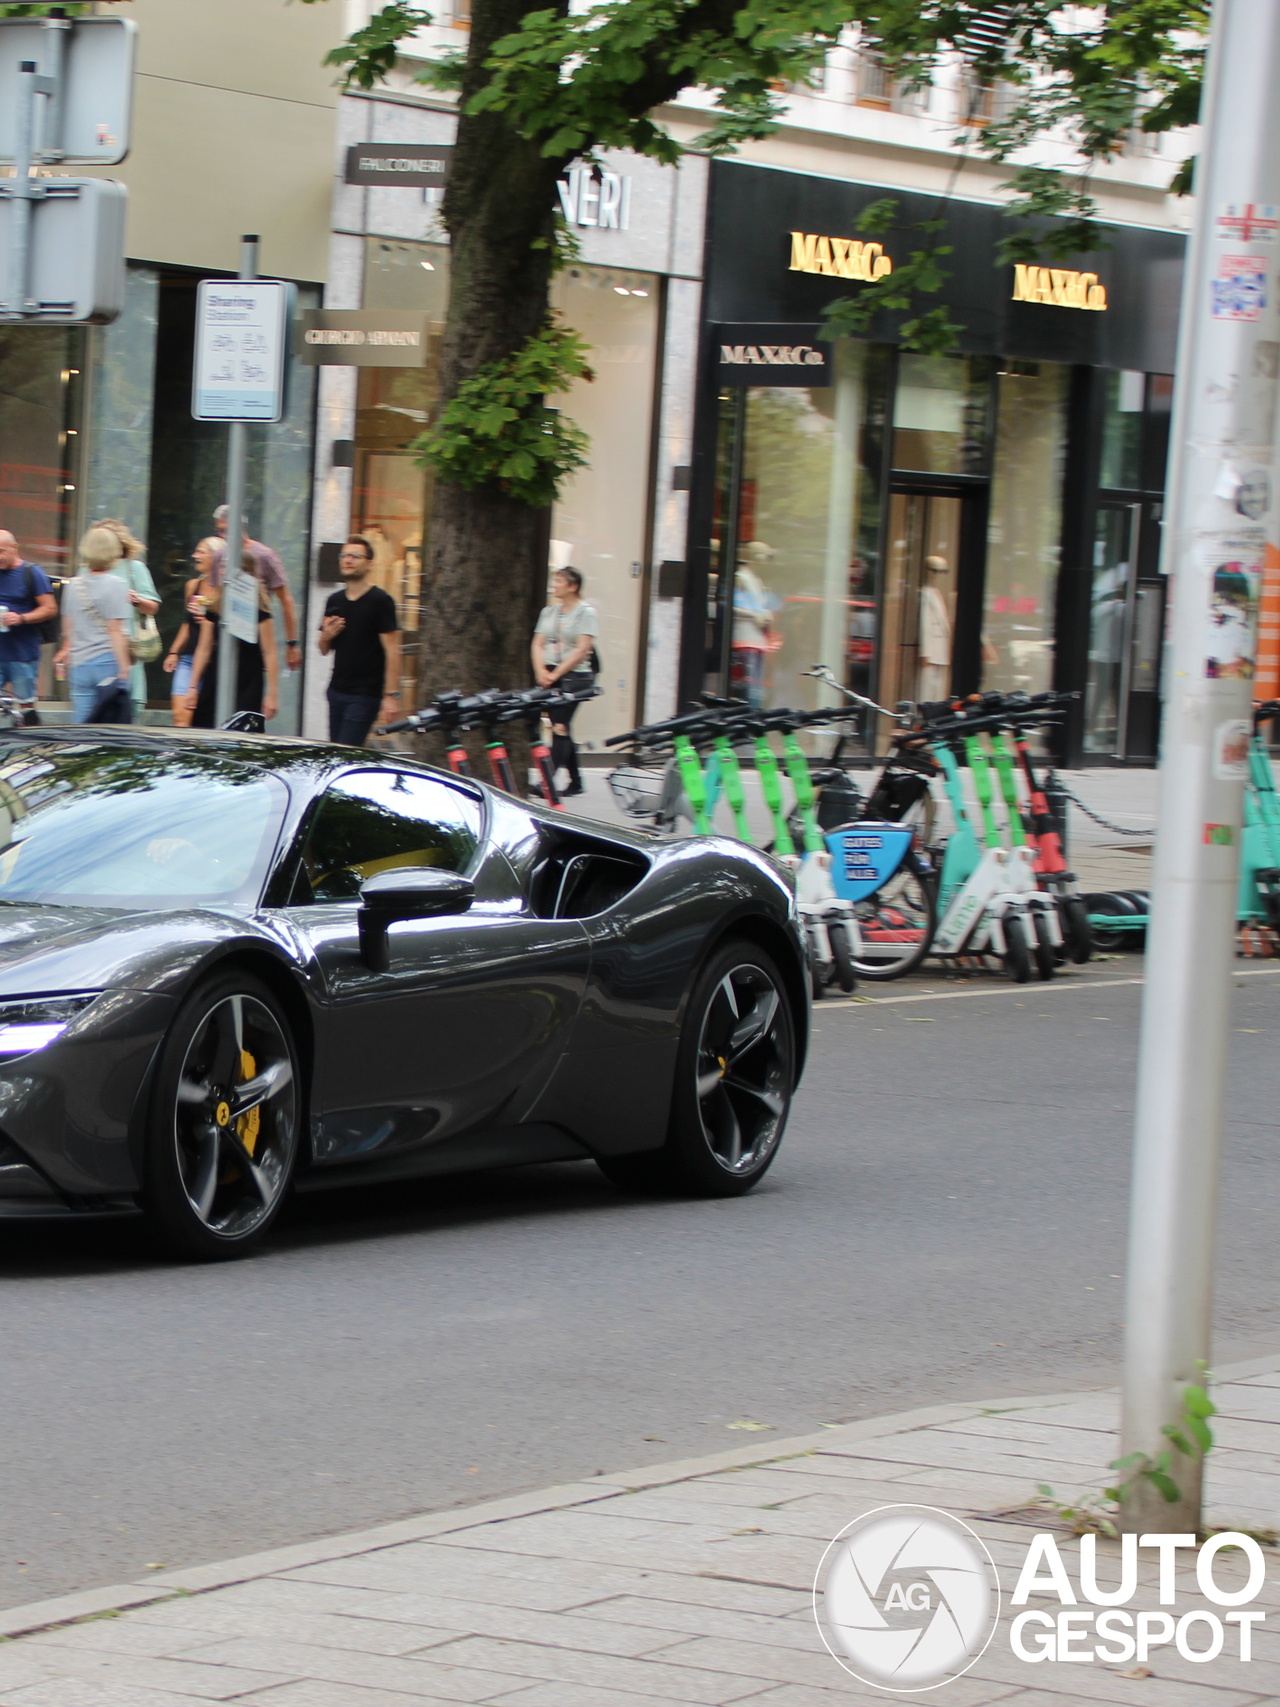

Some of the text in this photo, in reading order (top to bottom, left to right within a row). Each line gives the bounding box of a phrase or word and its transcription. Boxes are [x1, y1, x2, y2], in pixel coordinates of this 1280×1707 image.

[359, 157, 446, 173] FALCONERI
[1011, 263, 1108, 312] MAX&Co.
[365, 330, 420, 346] ARMANI
[719, 345, 824, 366] MAX&Co.
